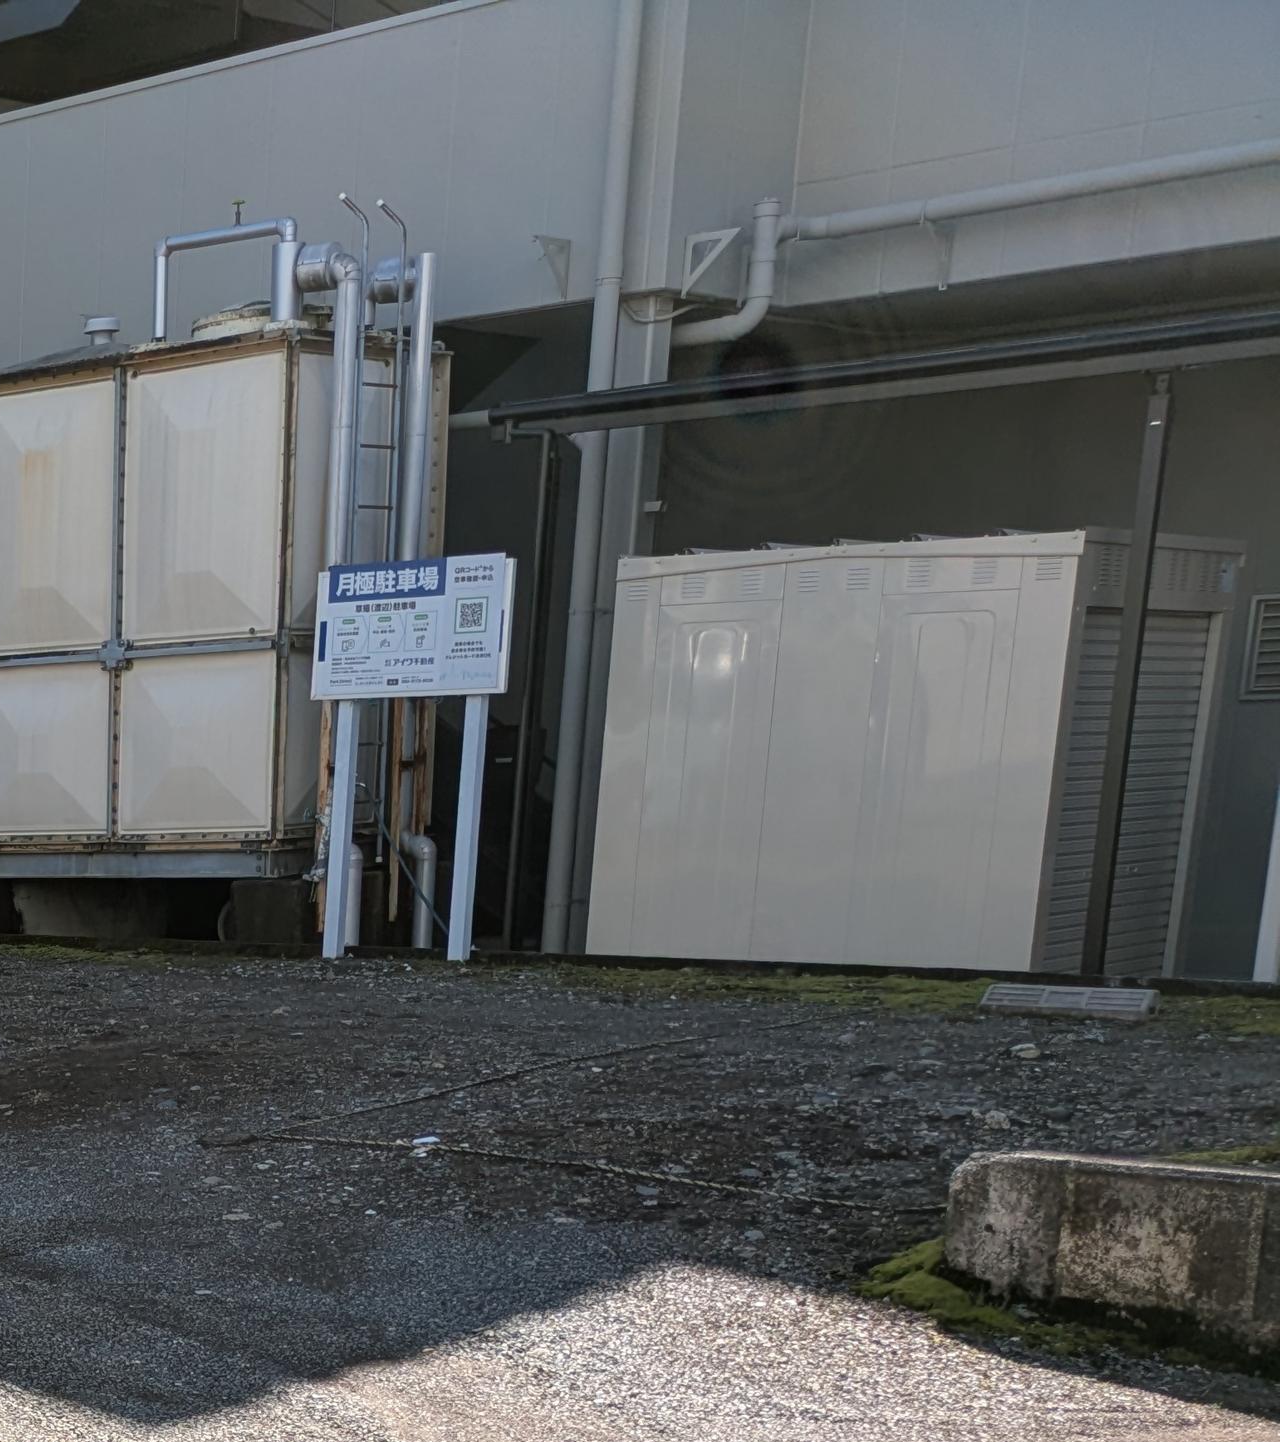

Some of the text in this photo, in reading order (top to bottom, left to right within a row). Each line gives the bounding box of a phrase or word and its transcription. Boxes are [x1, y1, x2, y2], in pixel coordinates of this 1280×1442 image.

[335, 566, 439, 596] 月極駐車場
